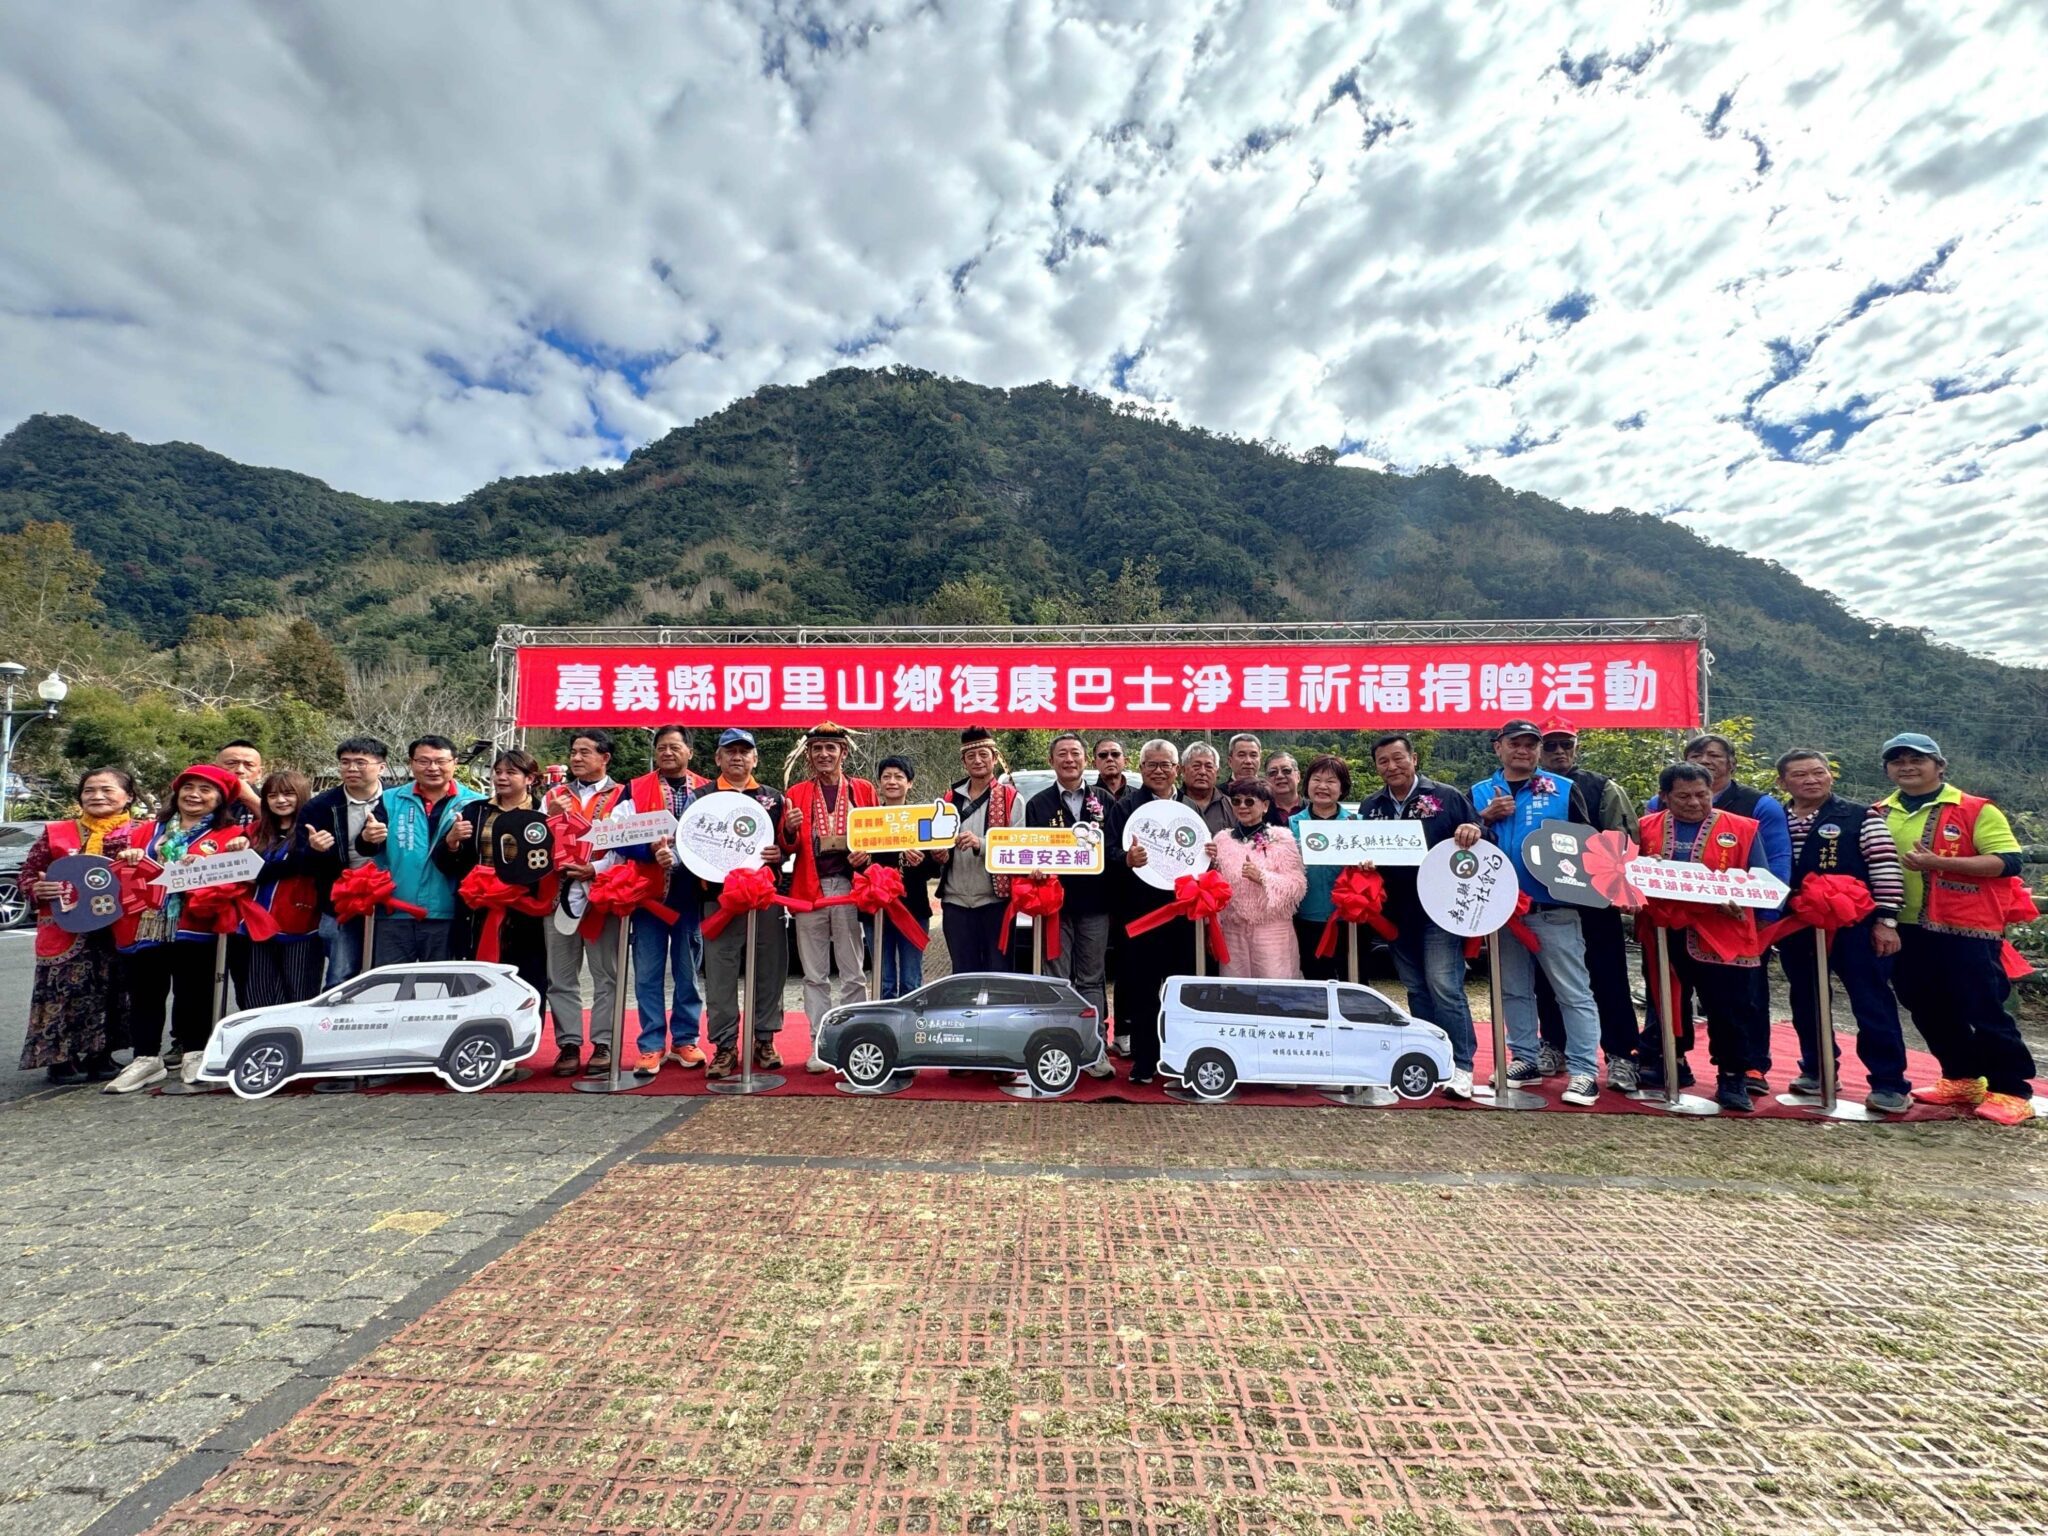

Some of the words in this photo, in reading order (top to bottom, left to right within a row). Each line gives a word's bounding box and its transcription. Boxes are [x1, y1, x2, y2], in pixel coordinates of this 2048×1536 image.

[554, 660, 1658, 714] 嘉義縣阿里山鄉復康巴士淨車祈福捐贈活動
[998, 848, 1090, 866] 社會安全網
[1632, 875, 1780, 901] 仁義湖岸大酒店捐贈
